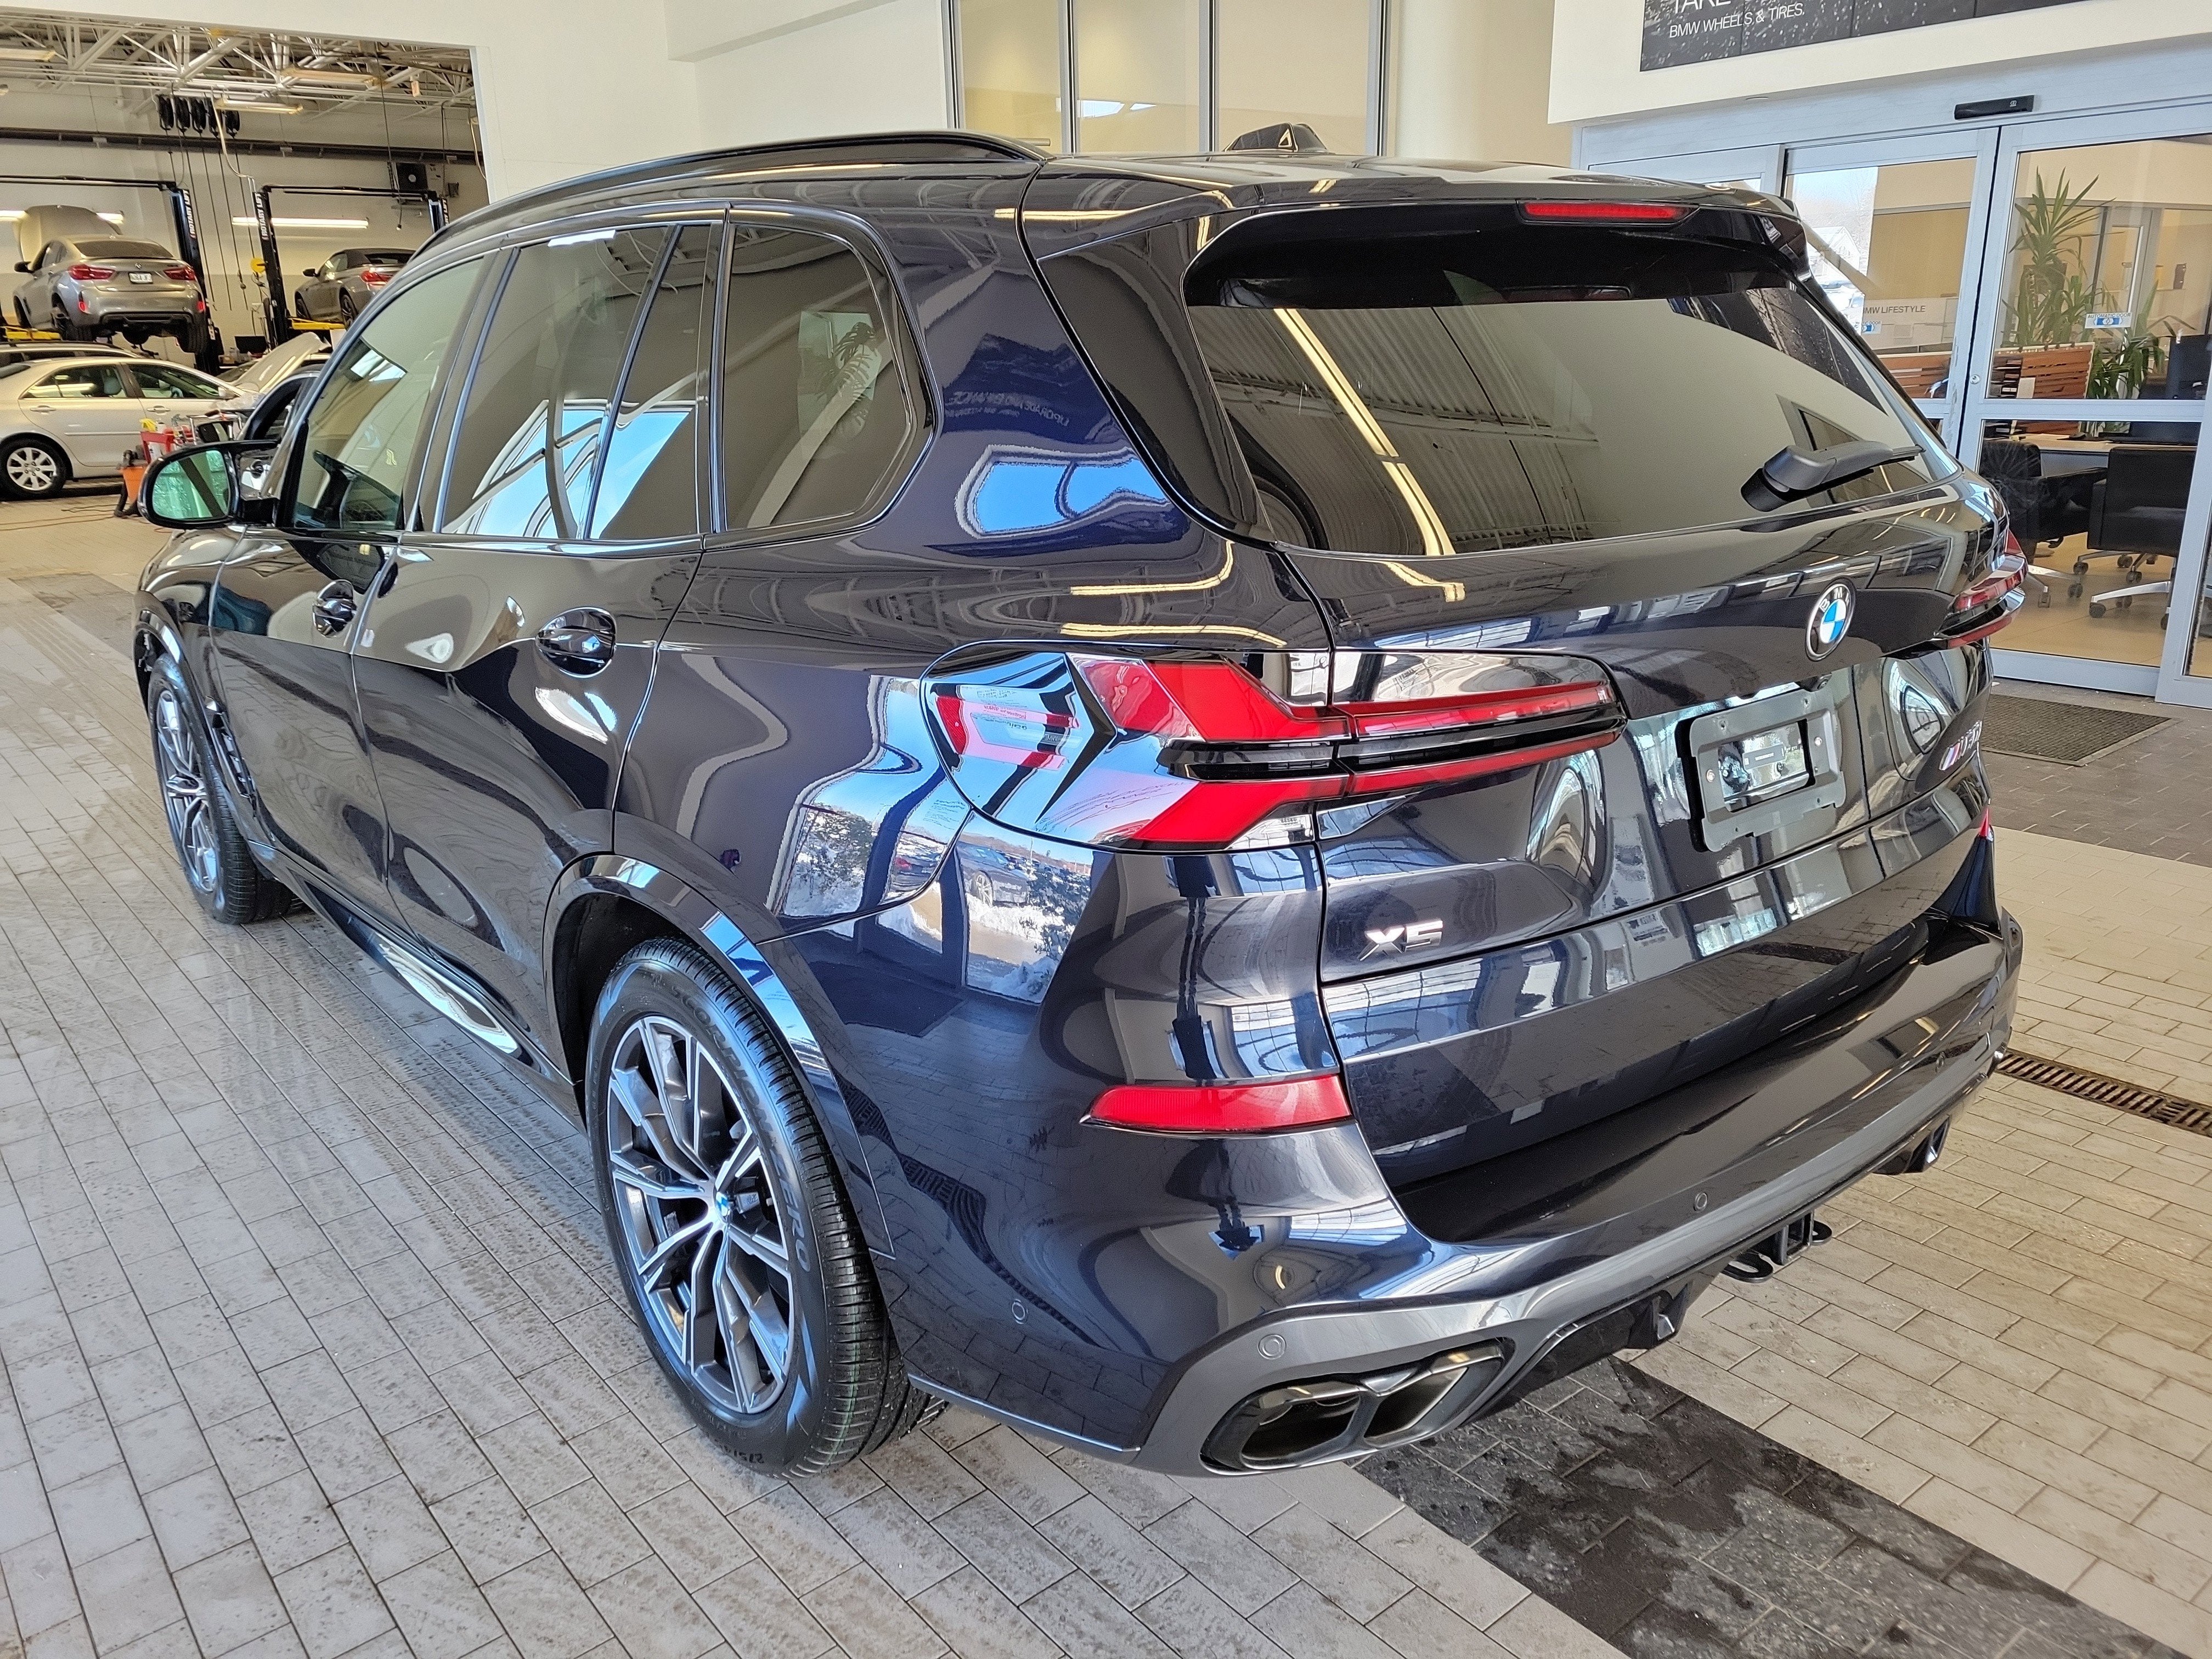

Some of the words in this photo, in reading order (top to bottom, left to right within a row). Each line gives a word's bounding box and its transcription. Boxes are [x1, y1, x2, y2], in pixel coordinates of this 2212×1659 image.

[1675, 0, 1731, 14] TA
[1669, 20, 1701, 38] BMW
[1703, 12, 1753, 32] WHEELS
[1756, 10, 1765, 23] &
[1768, 3, 1805, 20] TIRES.
[255, 192, 263, 208] LIFT
[257, 208, 268, 236] ROTARY
[1881, 306, 1926, 314] LIFESTYLE
[1357, 918, 1443, 961] X5
